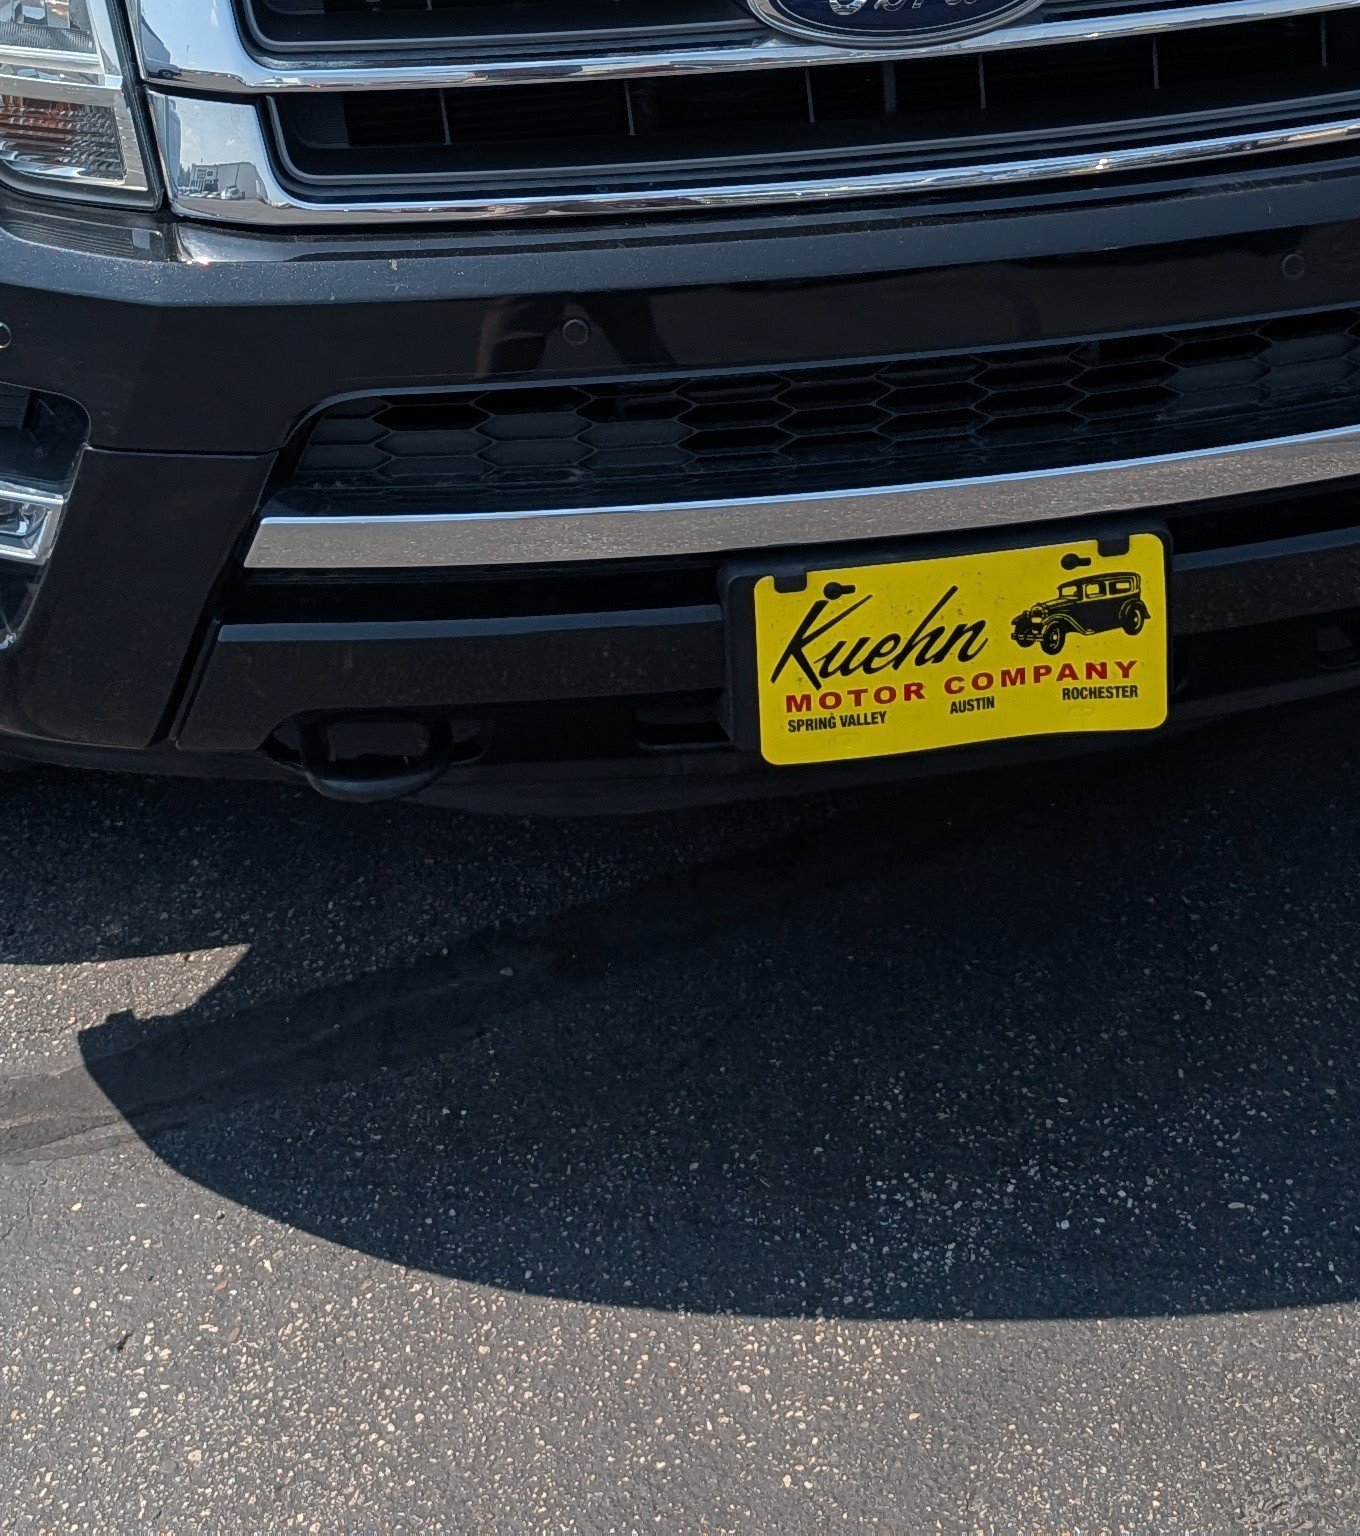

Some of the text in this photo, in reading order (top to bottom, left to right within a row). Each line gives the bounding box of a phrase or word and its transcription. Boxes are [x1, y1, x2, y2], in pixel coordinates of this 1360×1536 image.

[770, 585, 988, 691] Kuehn
[785, 660, 1138, 714] MOTOR COMPANY
[787, 684, 1139, 733] SPRING VALLEY AUSTIN ROCHESTER
